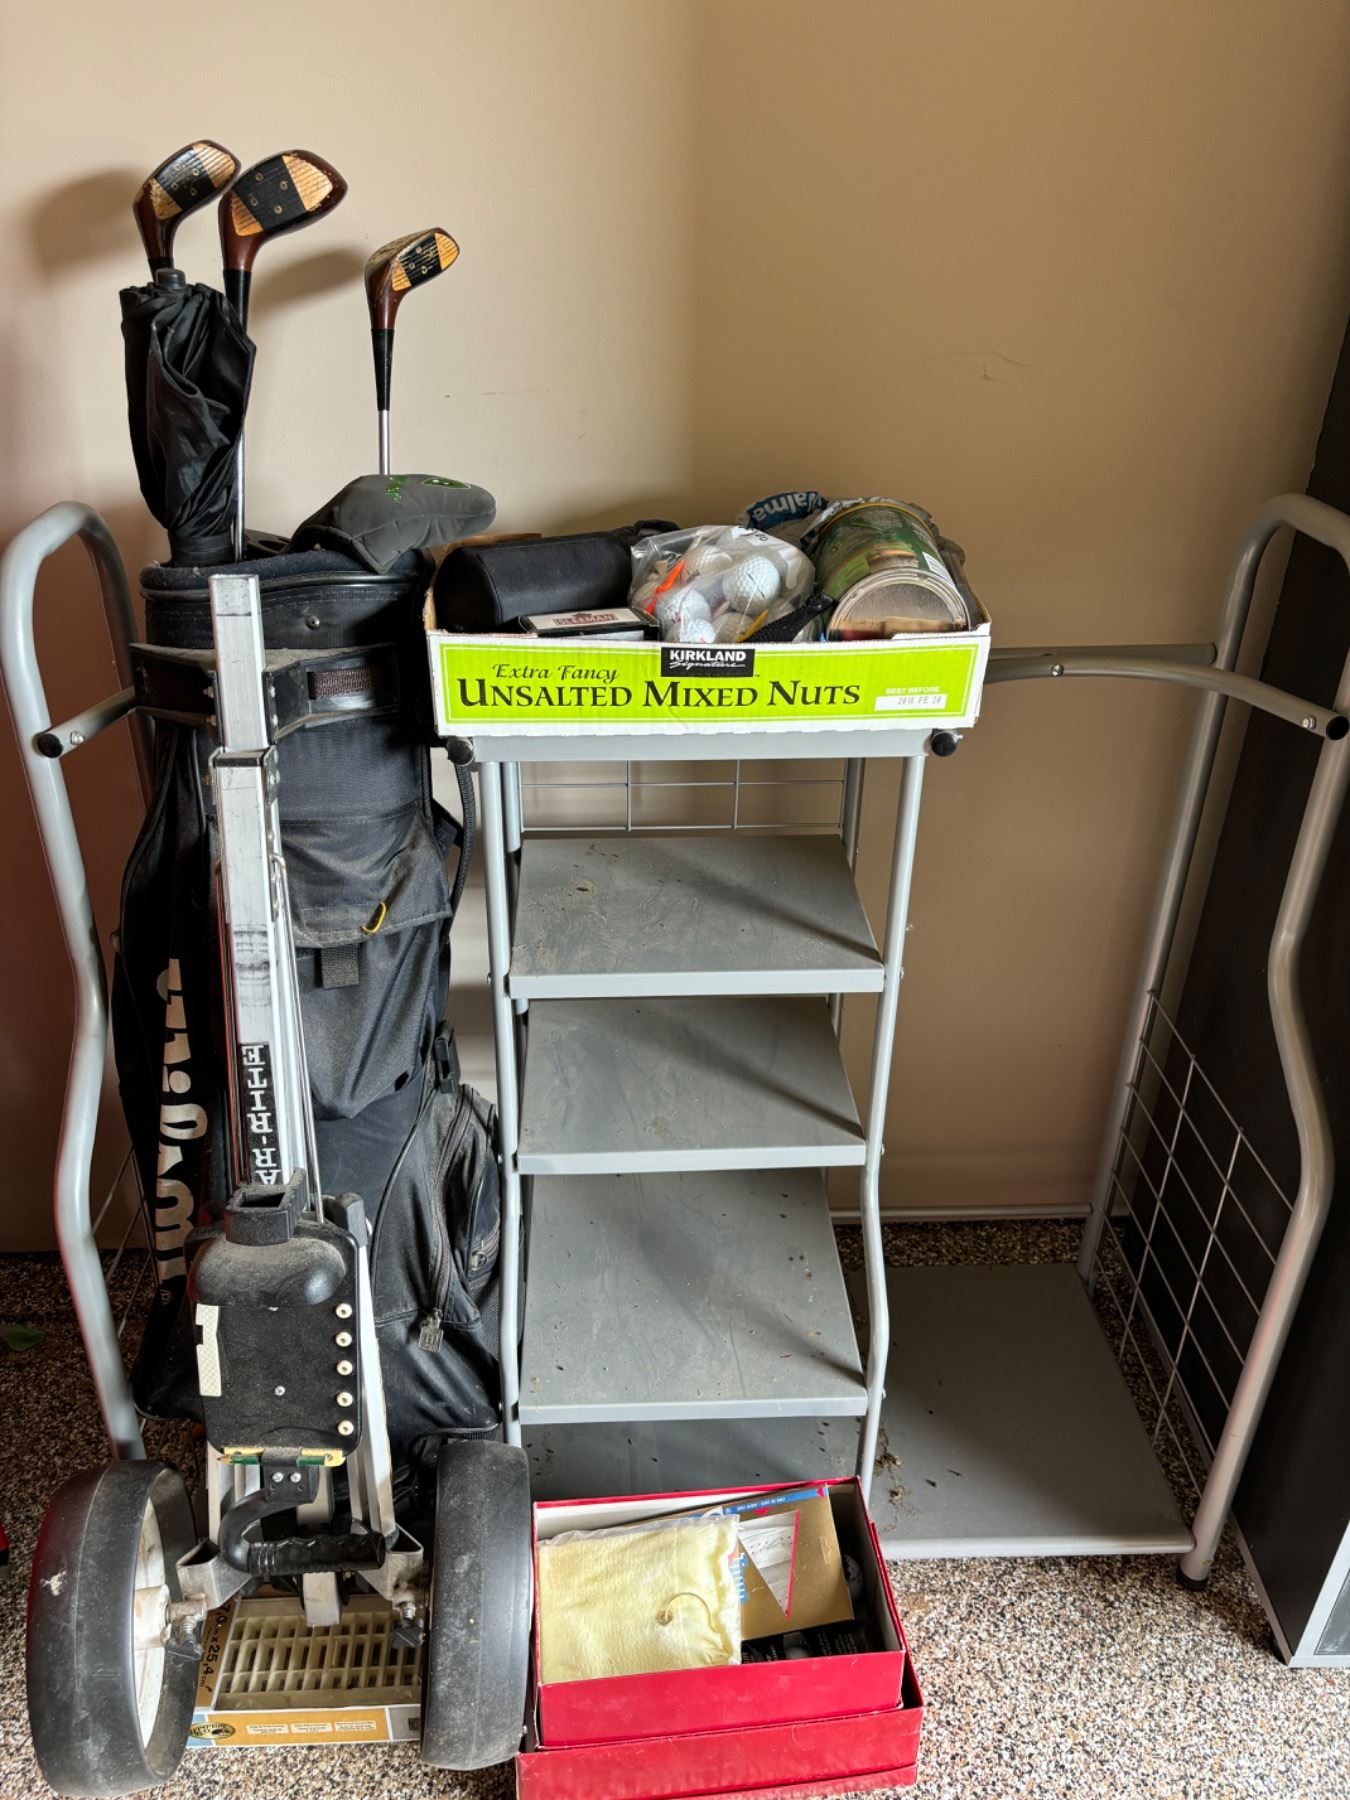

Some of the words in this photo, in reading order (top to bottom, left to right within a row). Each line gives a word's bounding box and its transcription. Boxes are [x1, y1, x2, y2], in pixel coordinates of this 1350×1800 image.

[669, 649, 747, 662] KIRKLAND
[669, 661, 746, 671] Signature
[492, 664, 550, 679] Extra
[558, 665, 619, 684] Fancy
[456, 678, 633, 707] UNSALTED
[642, 680, 758, 707] MIXED
[767, 680, 860, 706] NUTS
[908, 686, 940, 694] BEFORE
